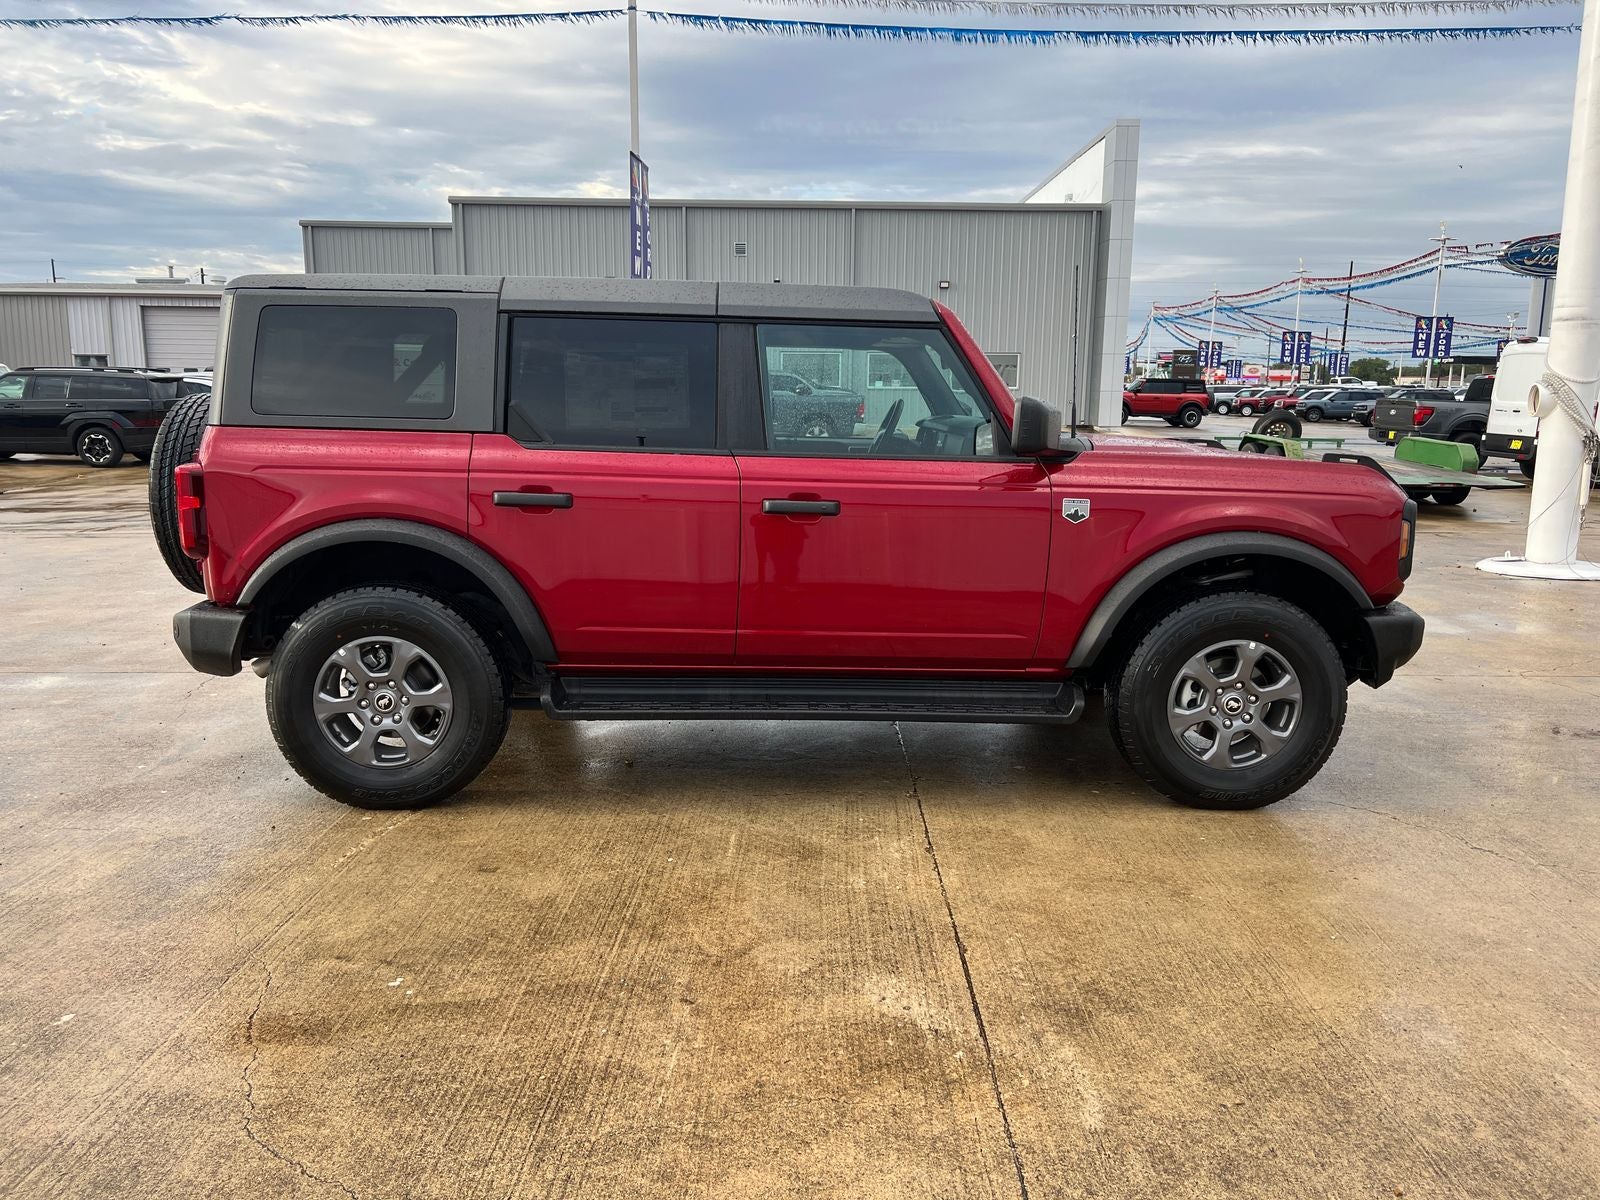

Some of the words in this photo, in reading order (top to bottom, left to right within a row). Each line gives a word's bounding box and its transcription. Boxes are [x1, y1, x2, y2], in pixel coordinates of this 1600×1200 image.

[1283, 343, 1292, 363] NEW
[1299, 343, 1307, 363] FORD
[1416, 333, 1426, 357] NEW
[1438, 333, 1447, 357] FORD
